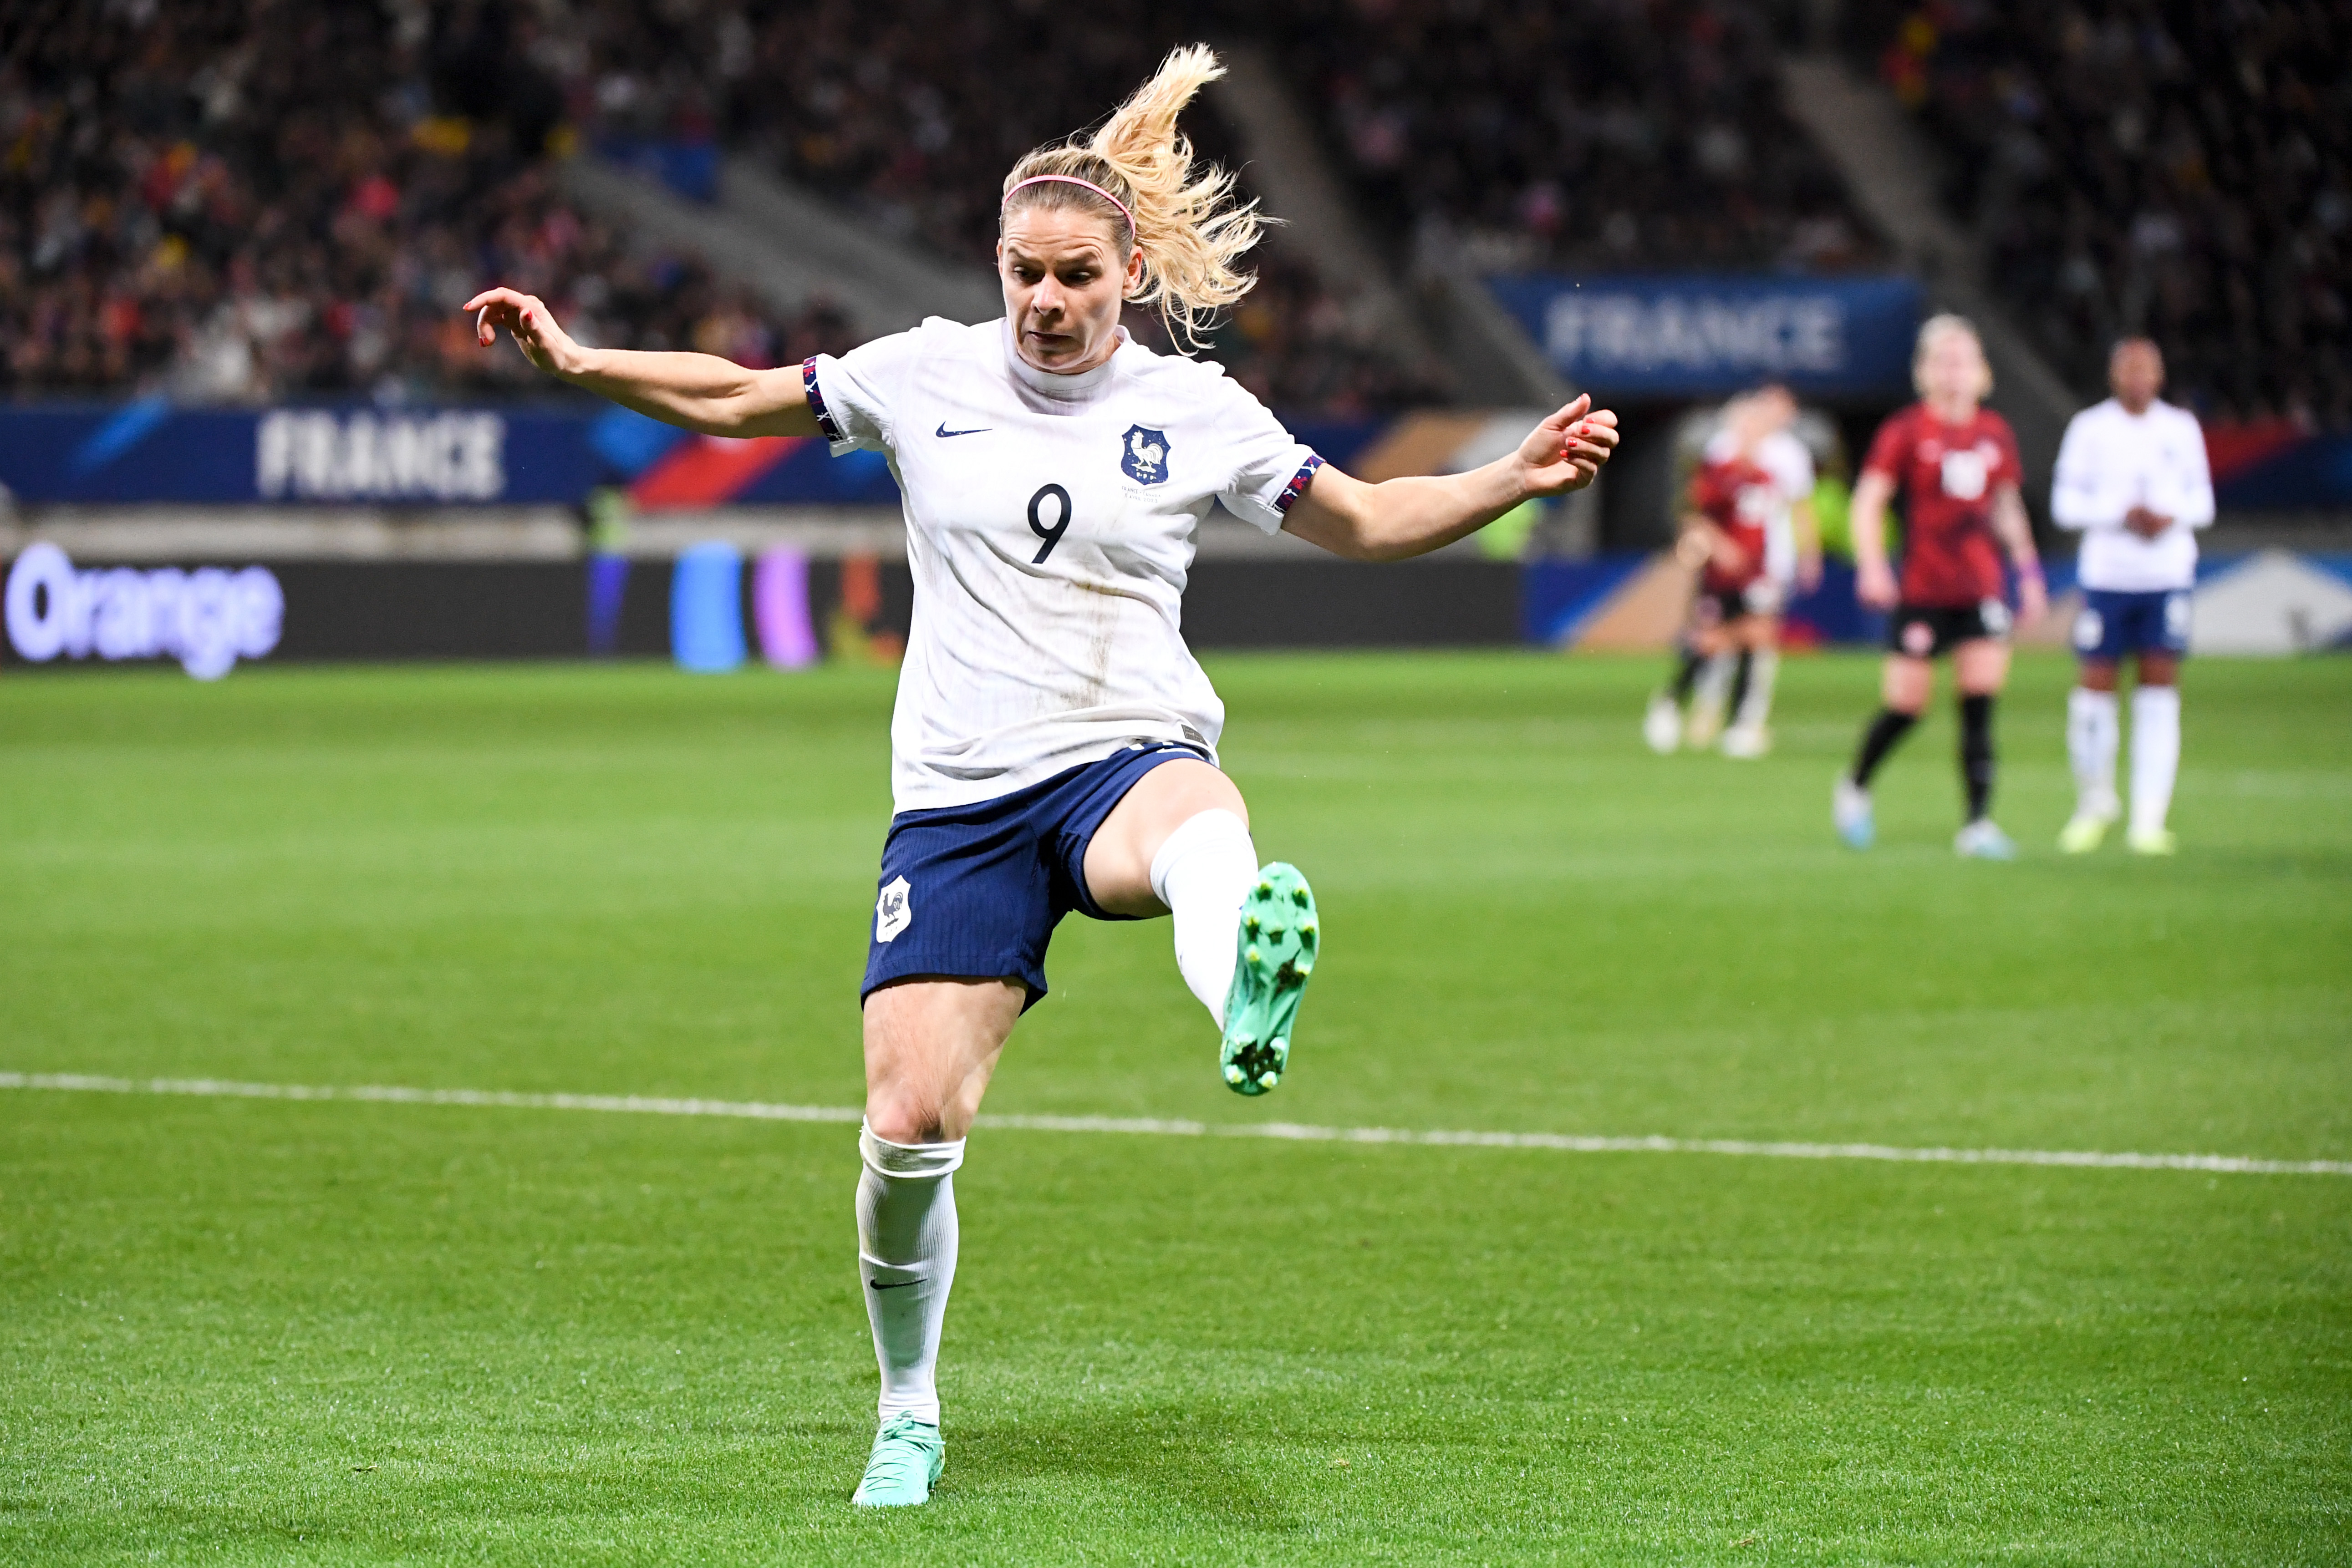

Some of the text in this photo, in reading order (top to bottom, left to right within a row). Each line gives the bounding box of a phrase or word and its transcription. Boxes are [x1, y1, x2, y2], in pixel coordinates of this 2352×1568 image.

[1548, 294, 1843, 368] FRANCE
[257, 410, 506, 499] FRANCE
[1121, 486, 1138, 494] FRANCE
[1028, 484, 1071, 563] 9
[5, 543, 283, 678] Orange
